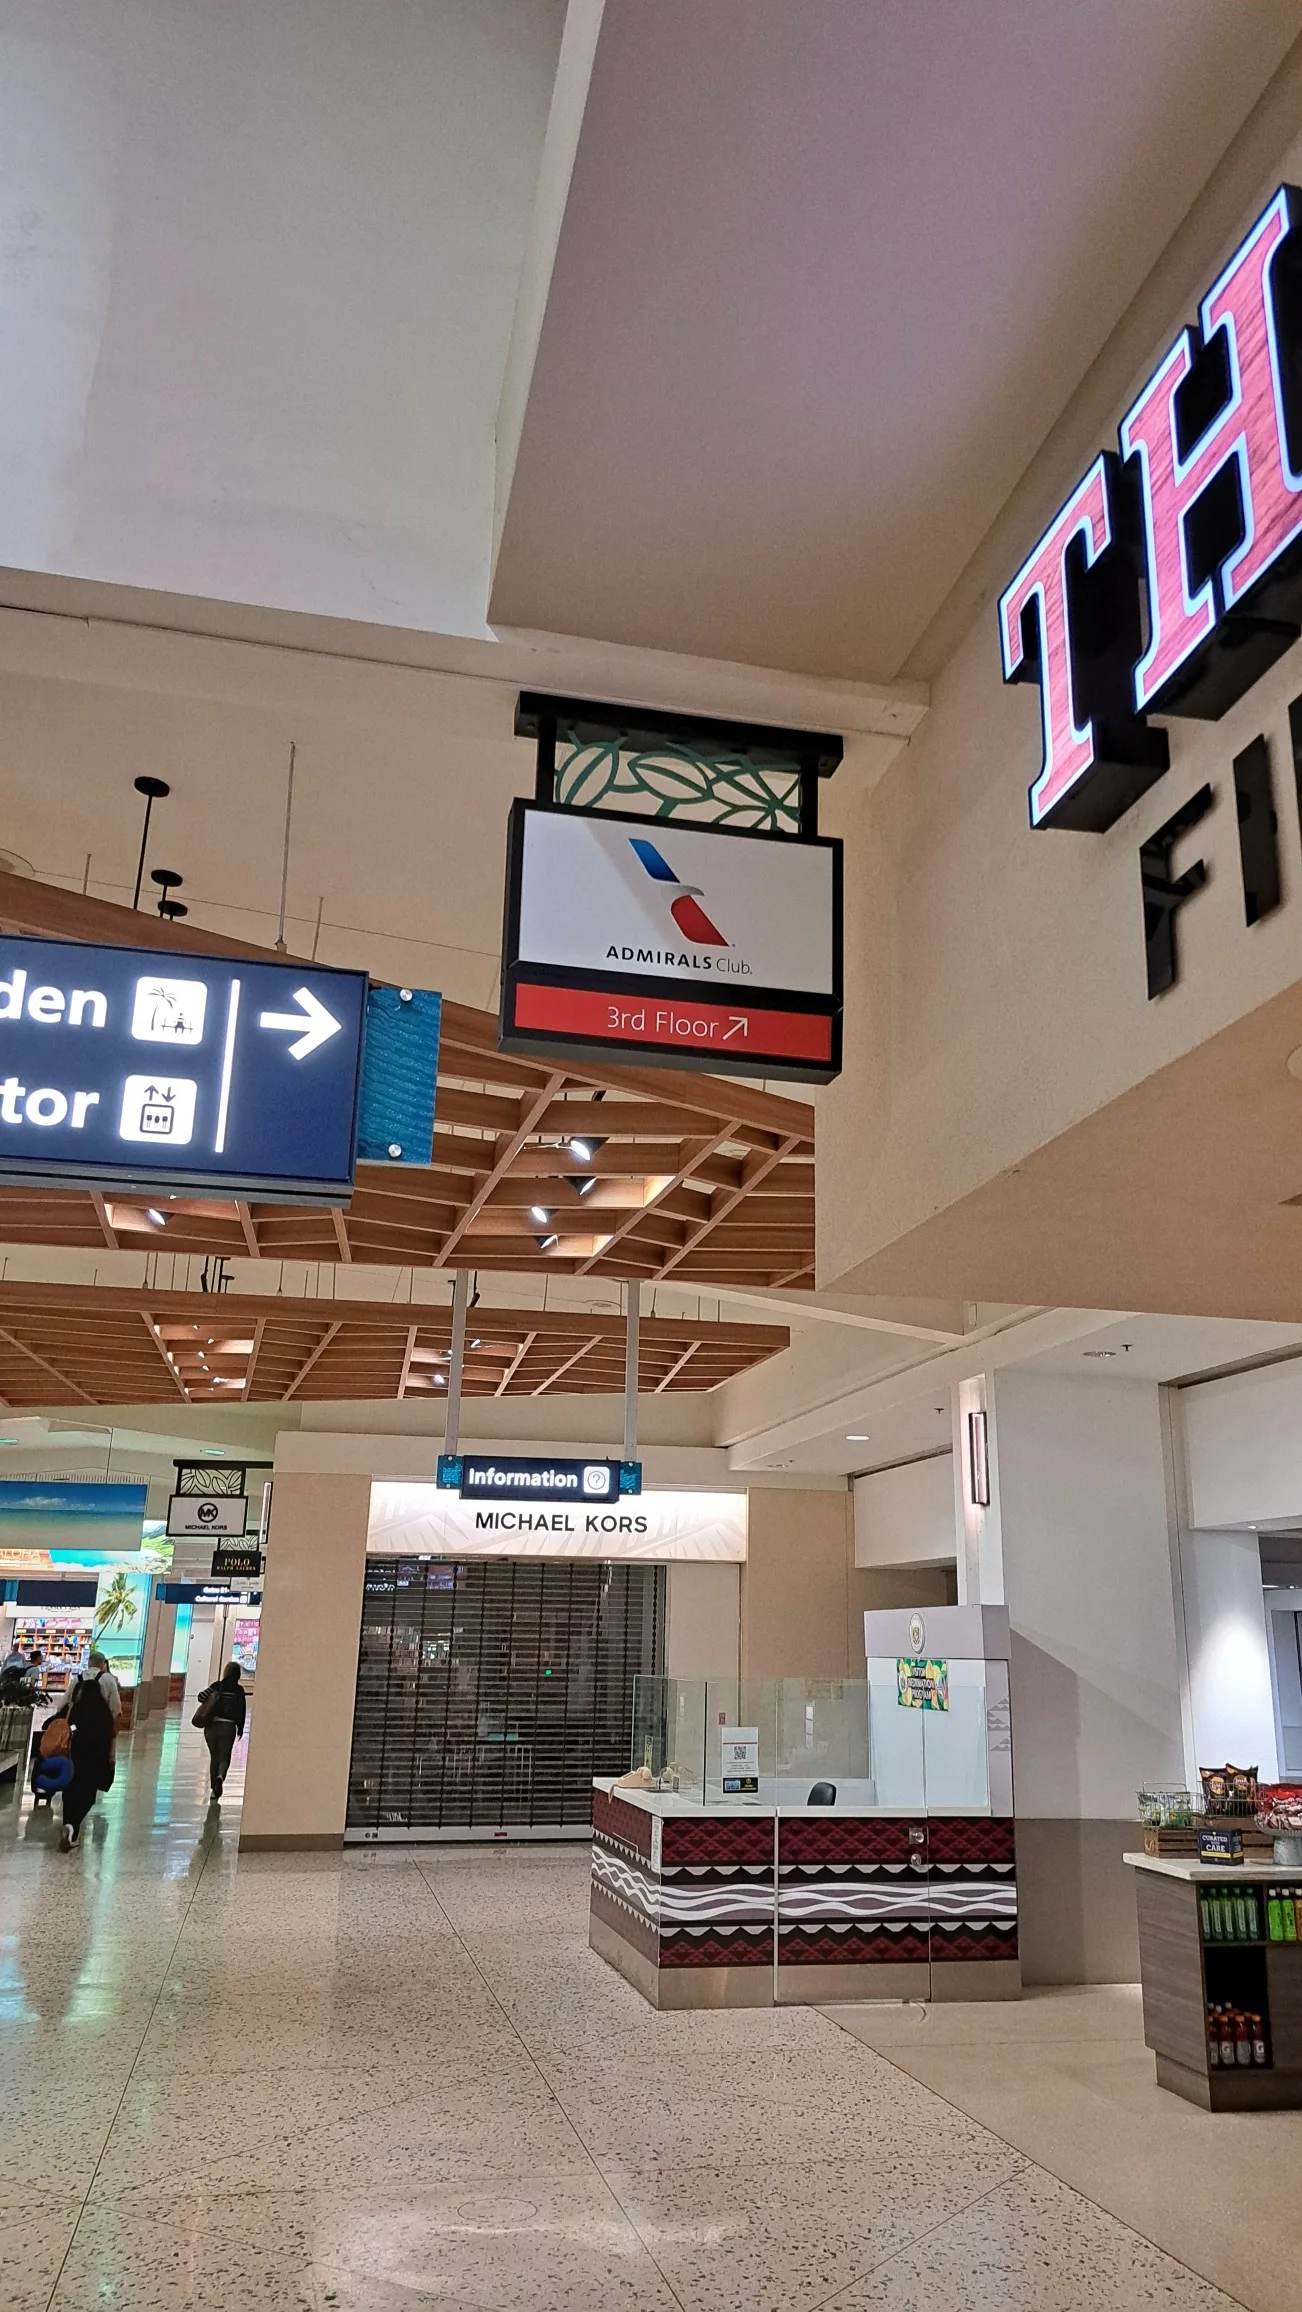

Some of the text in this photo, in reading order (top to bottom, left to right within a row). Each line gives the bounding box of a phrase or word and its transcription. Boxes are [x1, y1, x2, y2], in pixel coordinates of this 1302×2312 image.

[1139, 690, 1302, 1001] FI
[606, 945, 712, 970] ADMIRALS
[607, 1006, 719, 1038] 3rd Floor
[469, 1467, 578, 1488] Information
[475, 1512, 648, 1533] MICHAEL KORS
[224, 1557, 250, 1566] POLO
[1202, 1834, 1228, 1842] CURATED
[1205, 1844, 1226, 1853] CARE
